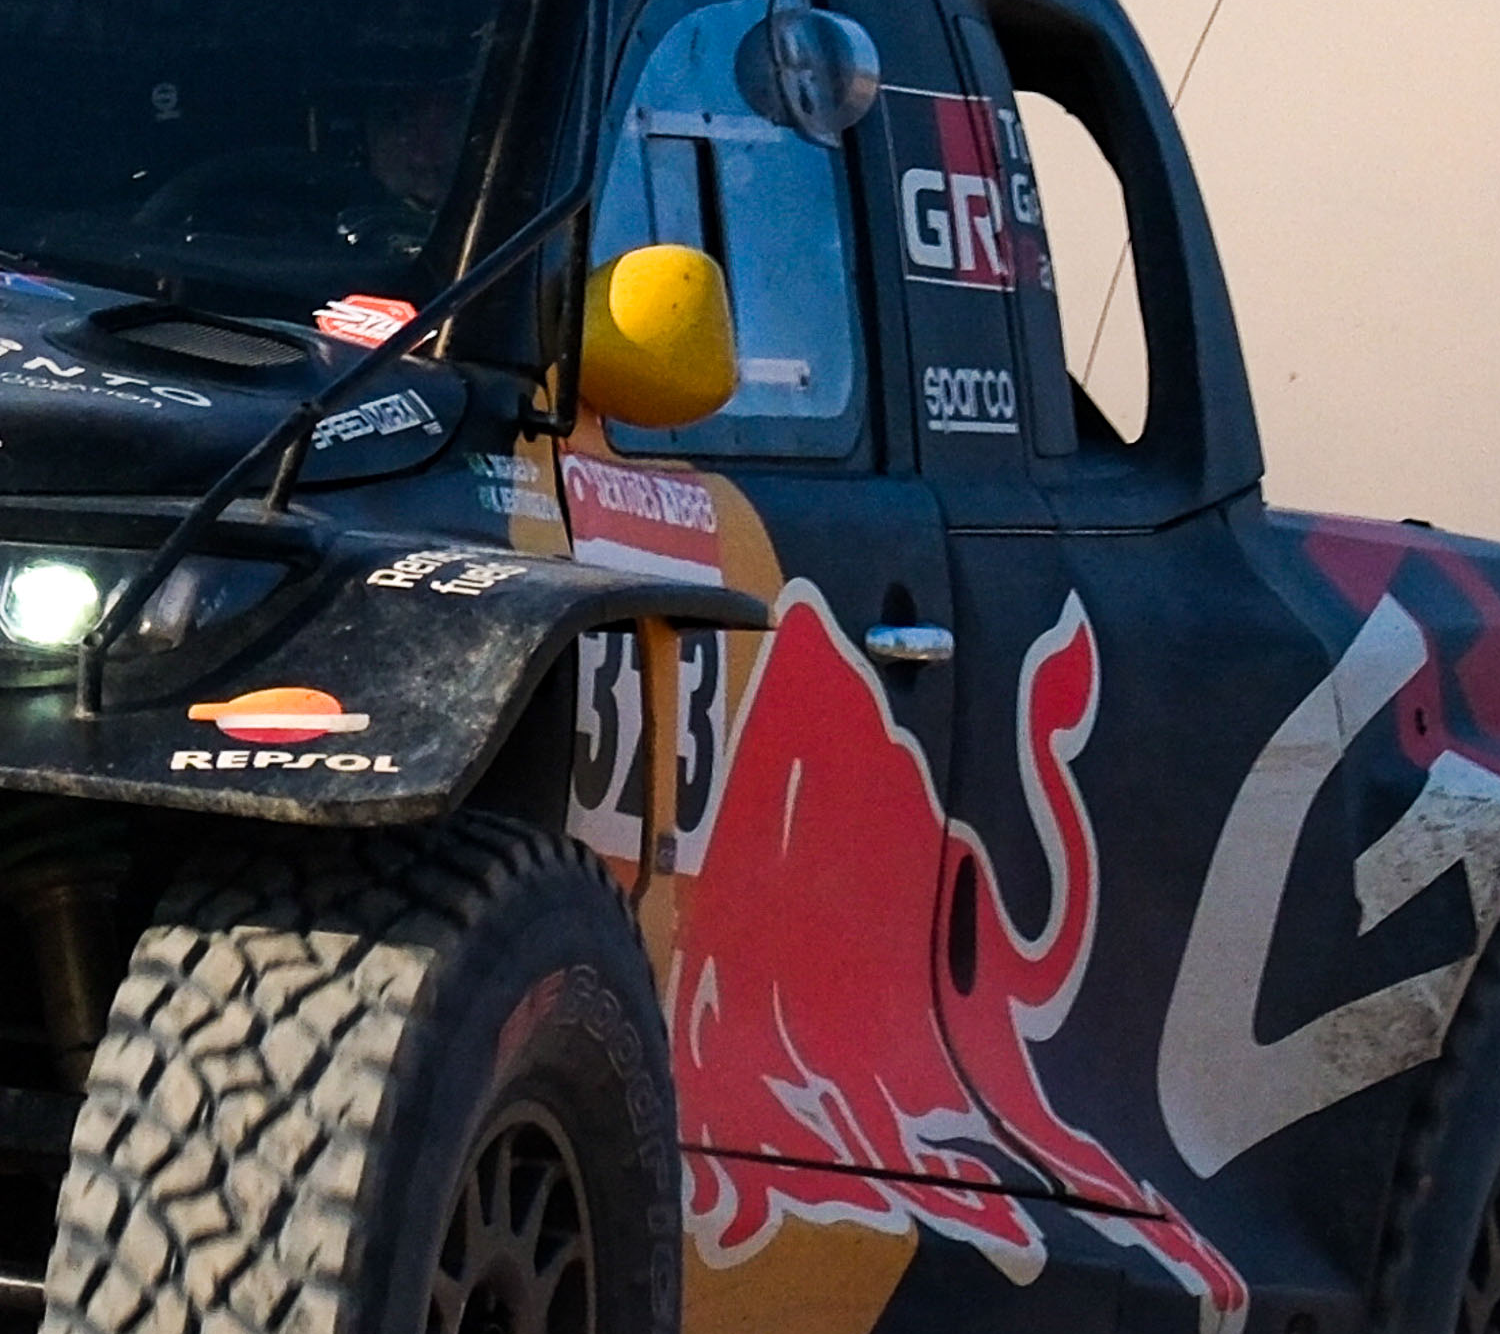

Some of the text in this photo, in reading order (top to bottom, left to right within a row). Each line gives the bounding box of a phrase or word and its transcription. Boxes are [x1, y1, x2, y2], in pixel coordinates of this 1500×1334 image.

[901, 167, 1009, 277] GR
[923, 366, 1019, 433] sparco
[170, 749, 400, 773] REPSOL
